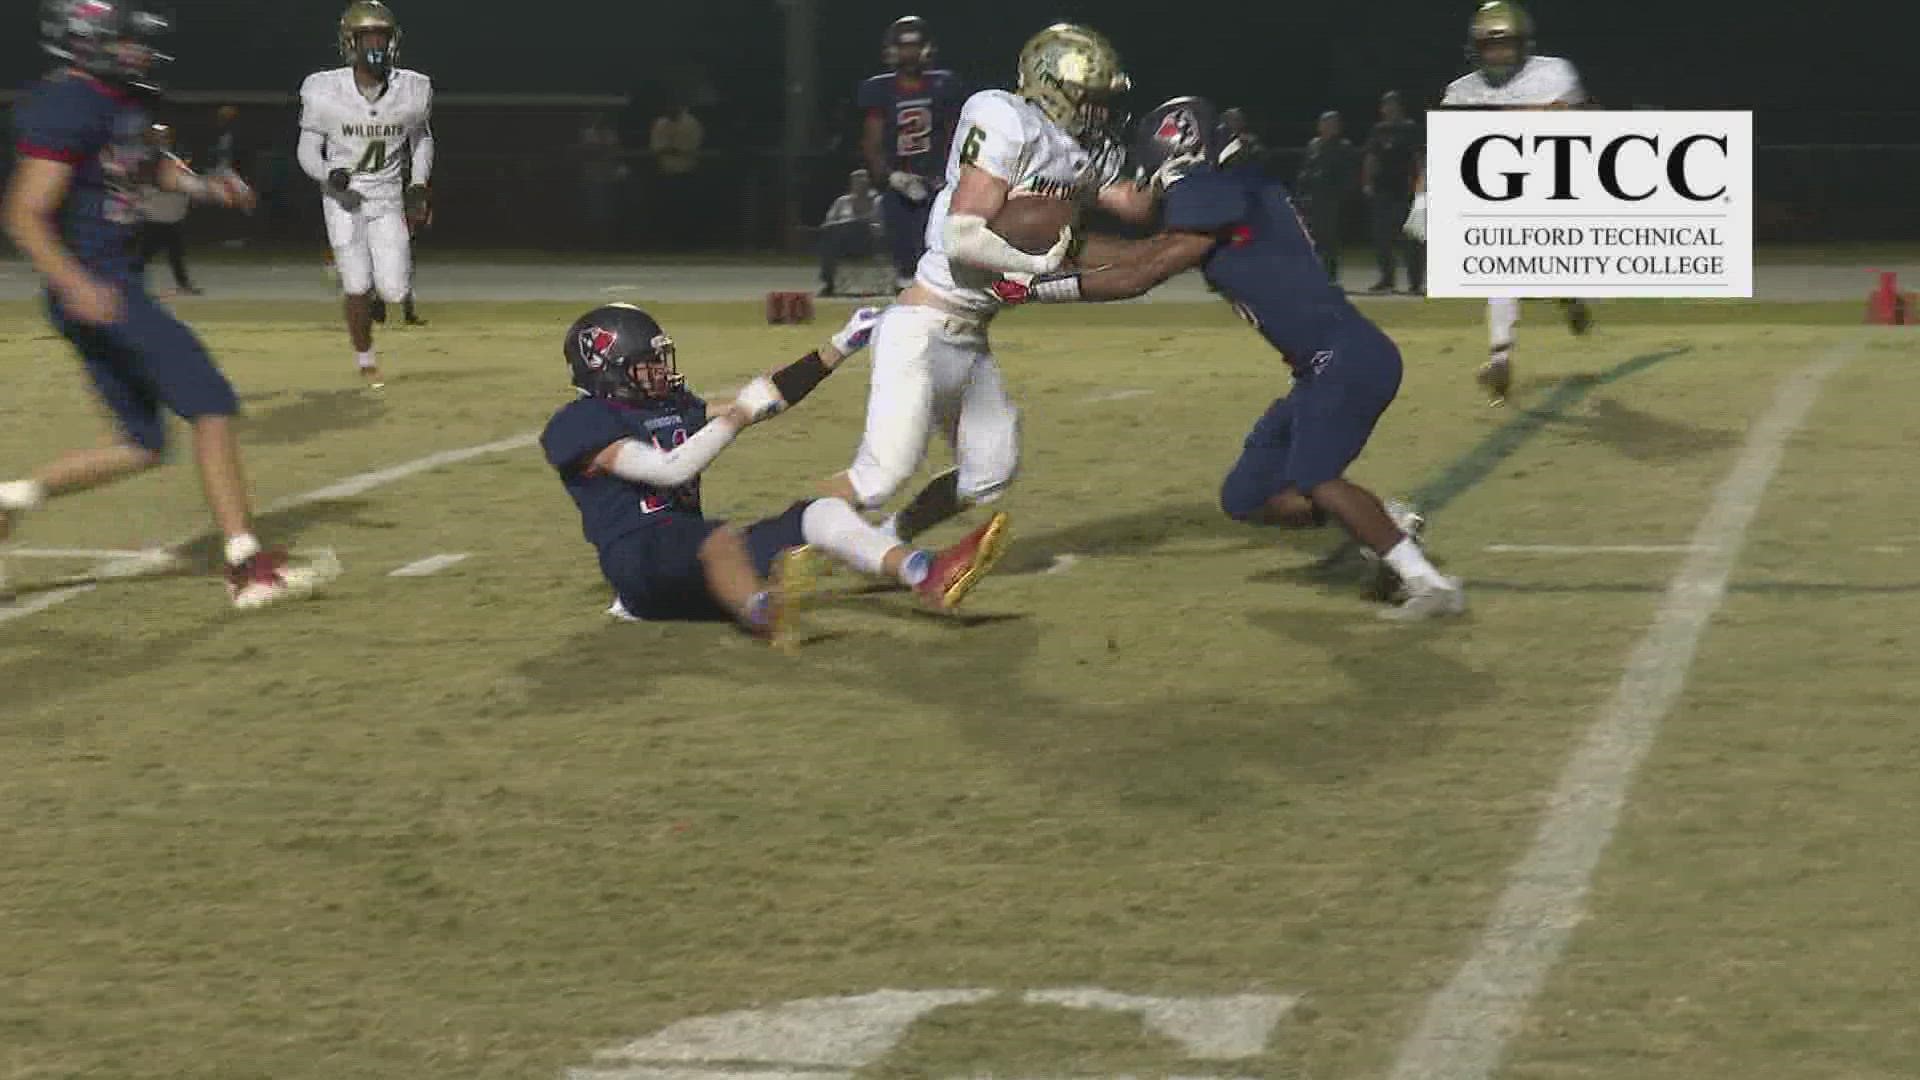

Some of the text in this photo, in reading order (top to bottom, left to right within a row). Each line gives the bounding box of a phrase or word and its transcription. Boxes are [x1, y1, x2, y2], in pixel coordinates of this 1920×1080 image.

[896, 107, 932, 156] 2
[960, 125, 987, 165] 6
[353, 139, 386, 174] 4
